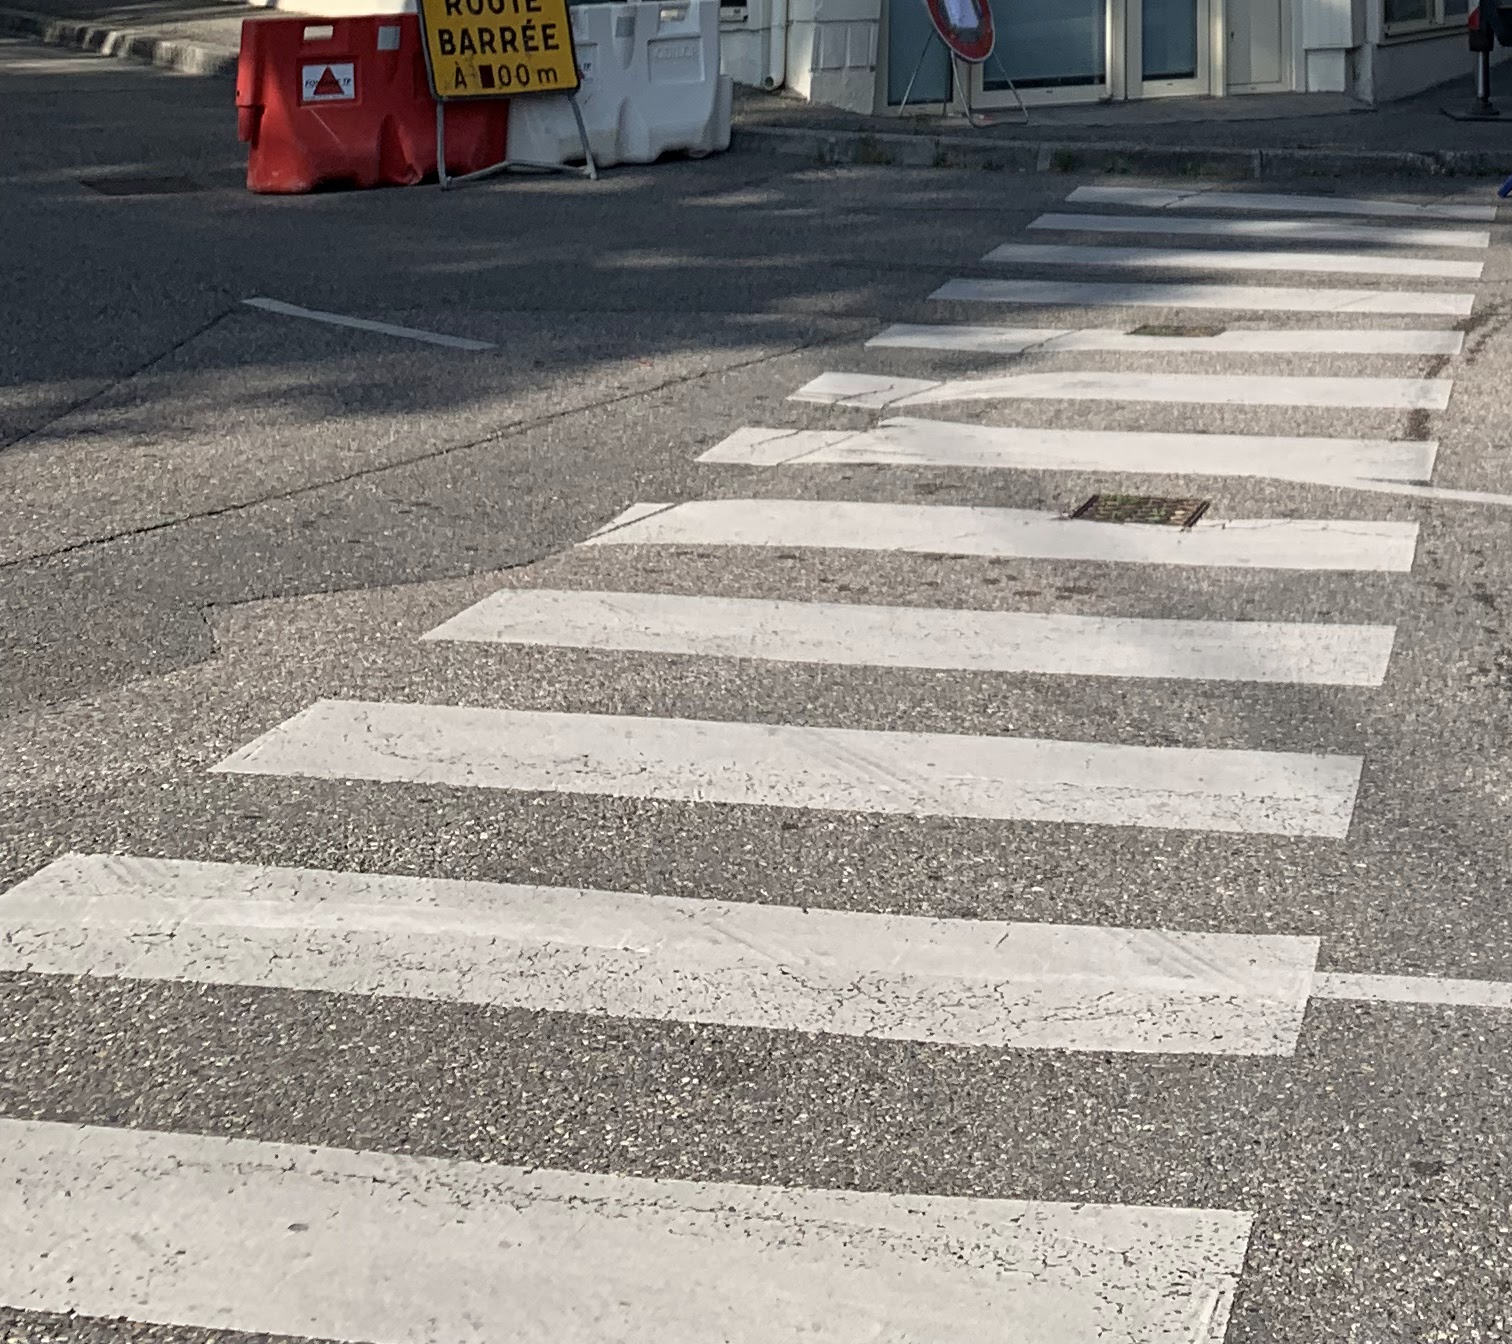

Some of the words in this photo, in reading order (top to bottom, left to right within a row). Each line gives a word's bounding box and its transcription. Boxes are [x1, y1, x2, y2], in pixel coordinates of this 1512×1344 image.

[438, 19, 560, 56] BARRÉE
[454, 61, 468, 89] À
[537, 66, 558, 84] m
